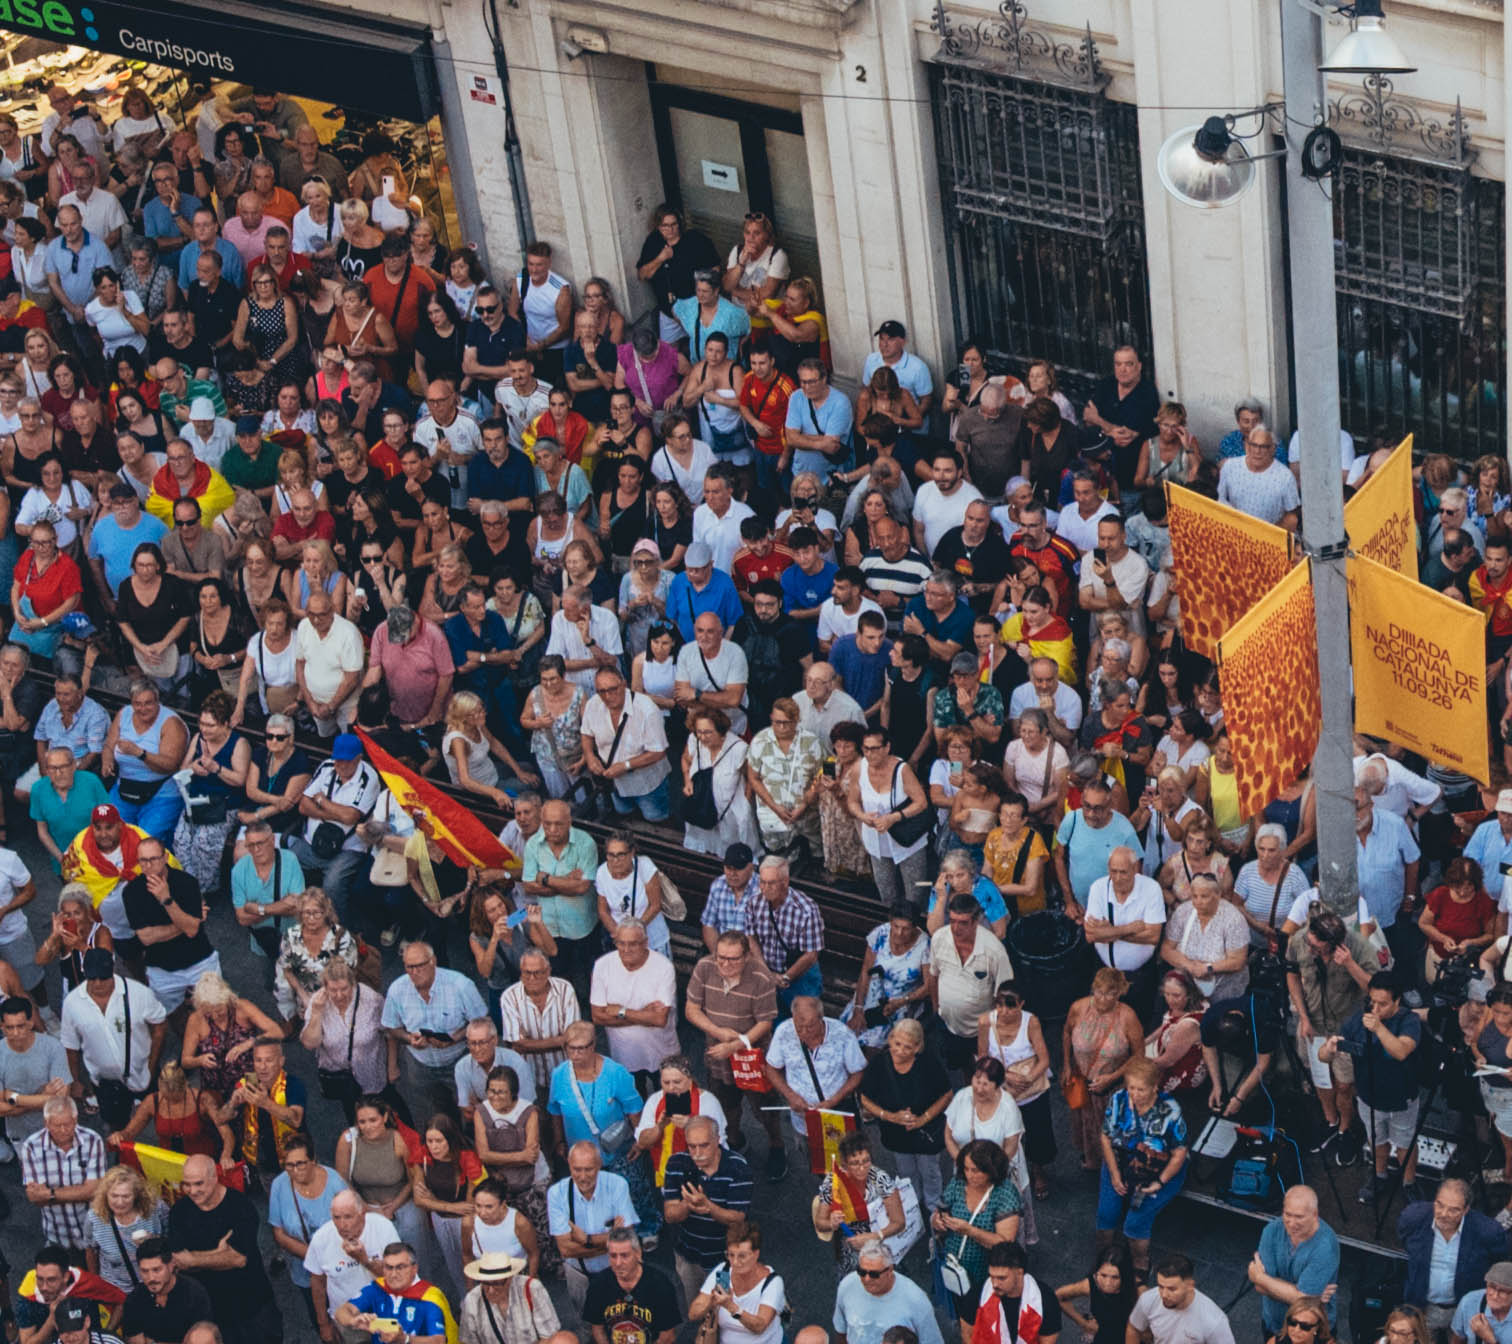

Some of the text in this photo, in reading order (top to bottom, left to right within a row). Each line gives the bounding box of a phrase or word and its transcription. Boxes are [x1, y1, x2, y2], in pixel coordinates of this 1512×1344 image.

[118, 28, 236, 73] Carpisports
[1366, 624, 1480, 692] NACIONAL DE
[1373, 645, 1473, 704] CATALUNYA
[1392, 670, 1453, 710] 11.09.26
